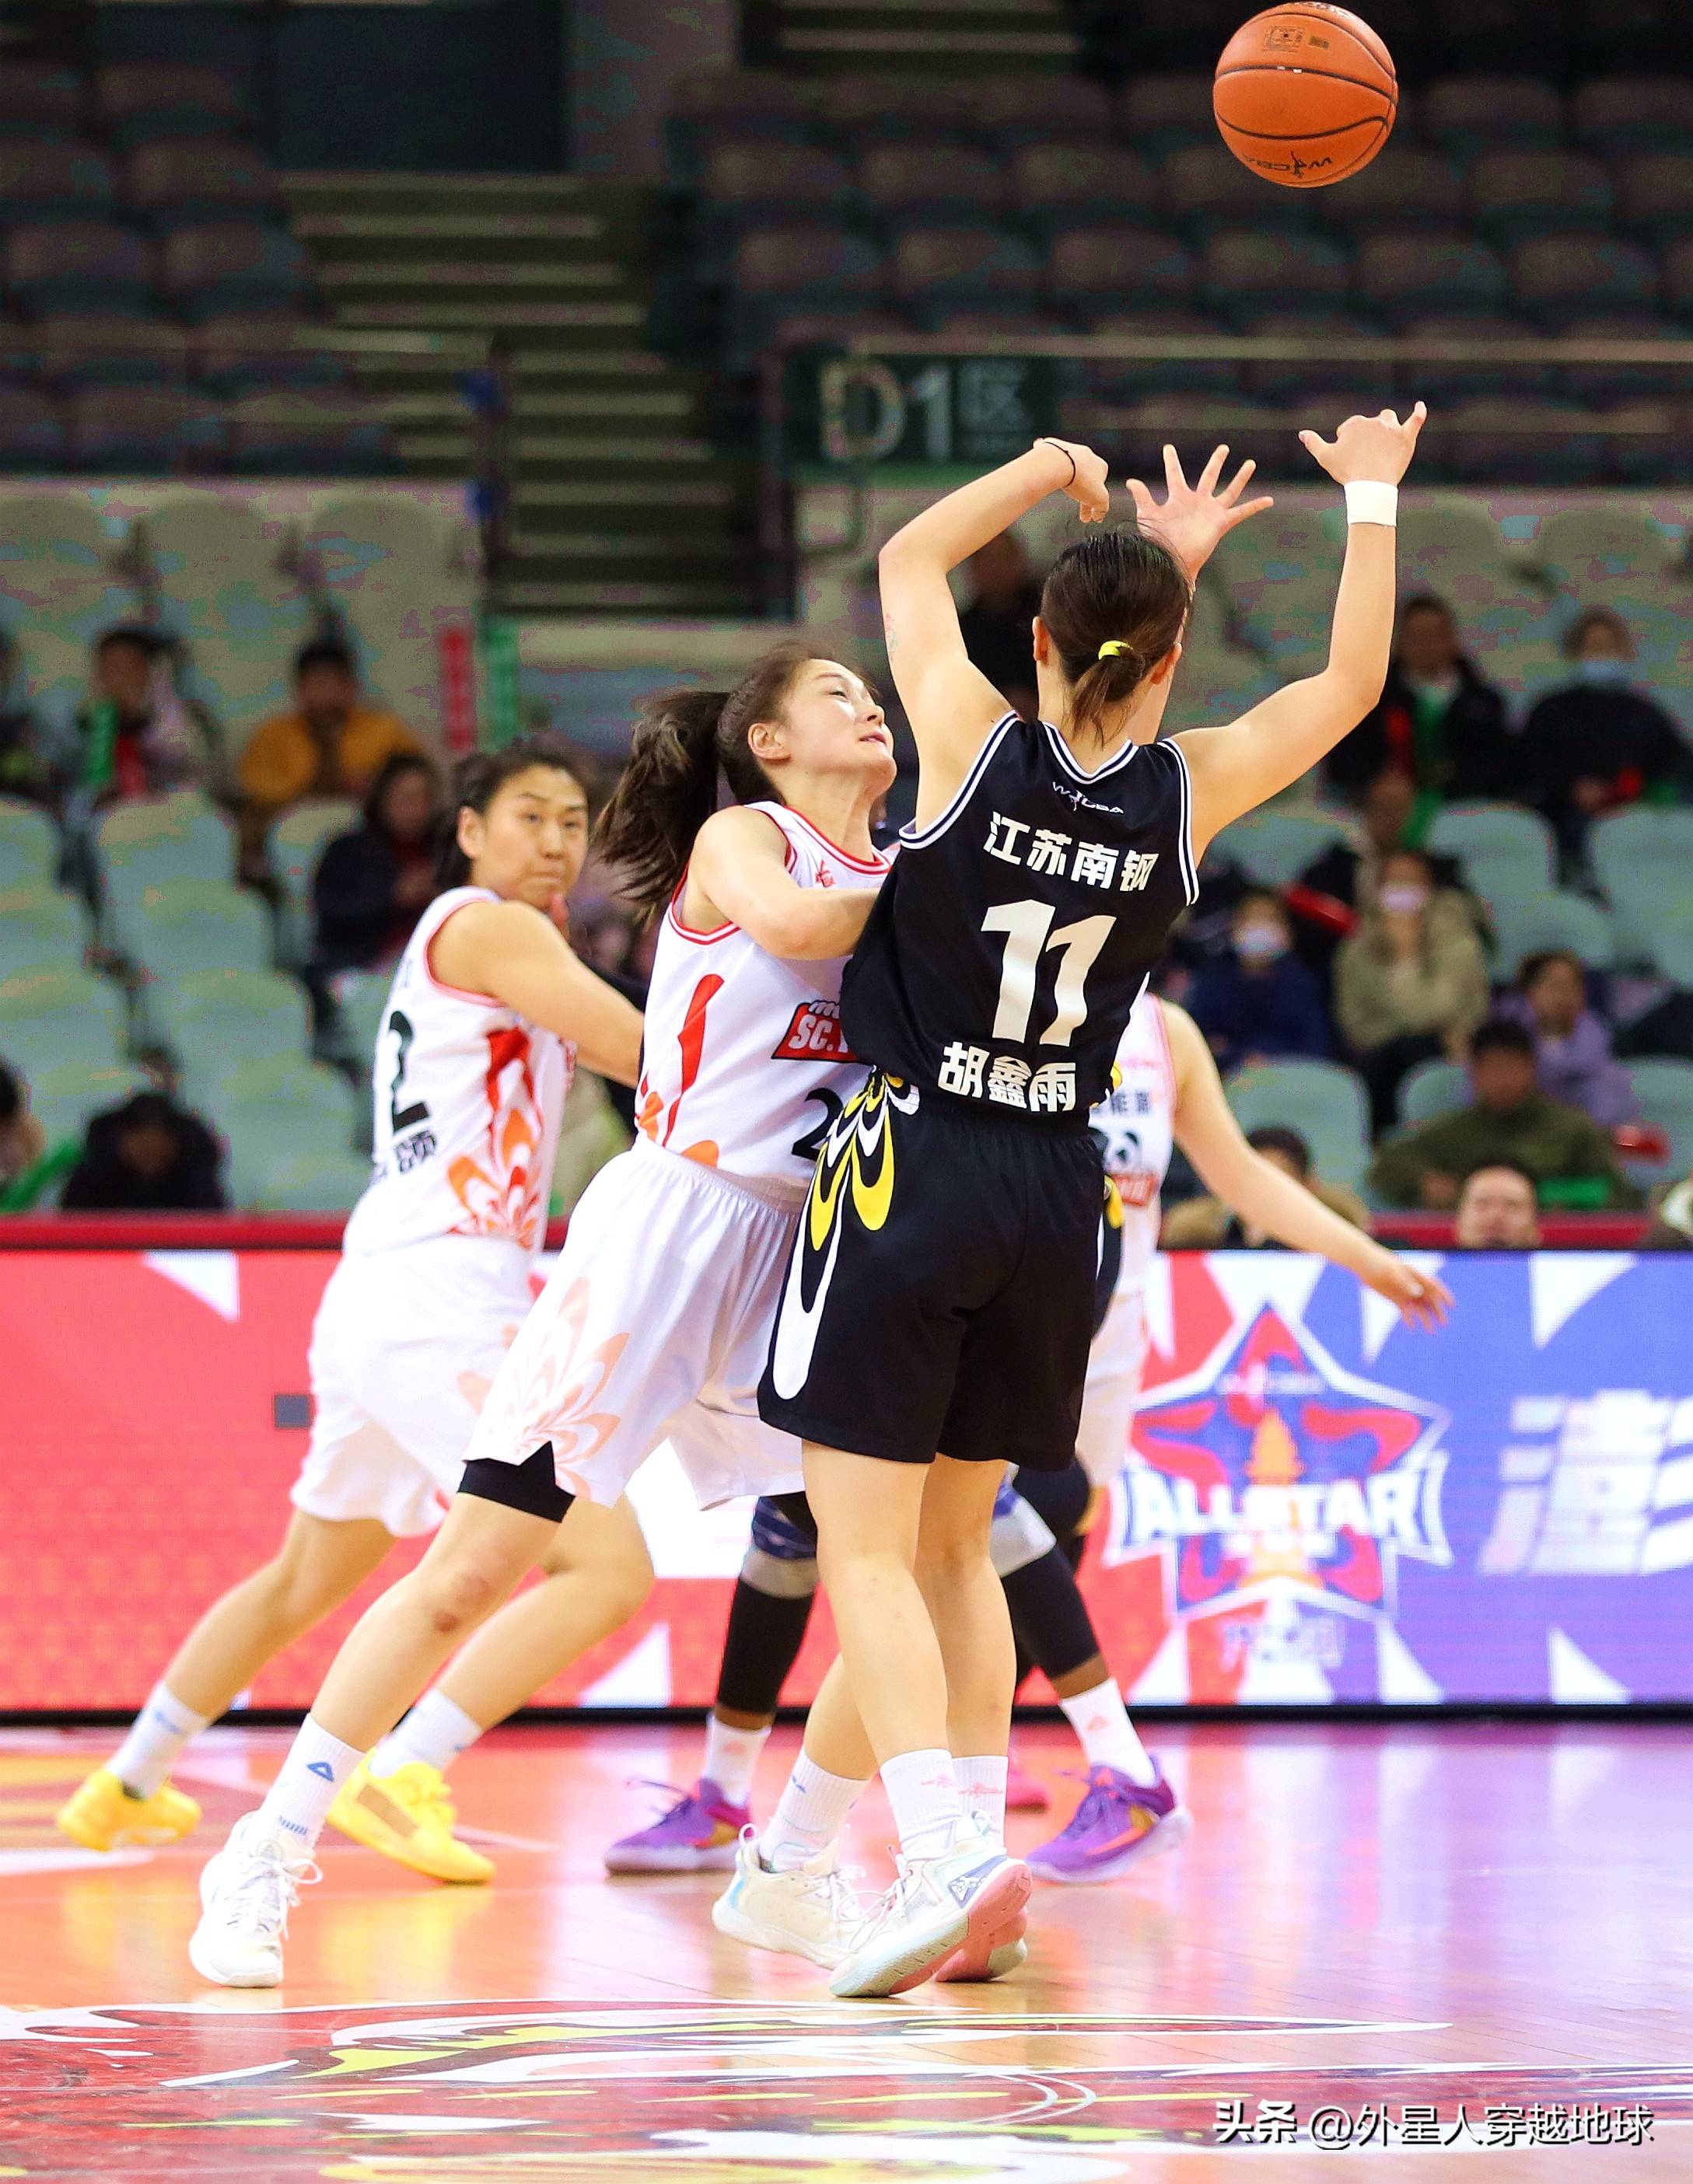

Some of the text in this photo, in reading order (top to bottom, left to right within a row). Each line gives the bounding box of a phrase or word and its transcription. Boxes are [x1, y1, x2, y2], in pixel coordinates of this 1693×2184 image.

[982, 811, 1160, 892] 江苏南钢
[981, 899, 1118, 1047] 11
[937, 1041, 1076, 1113] 胡鑫雨
